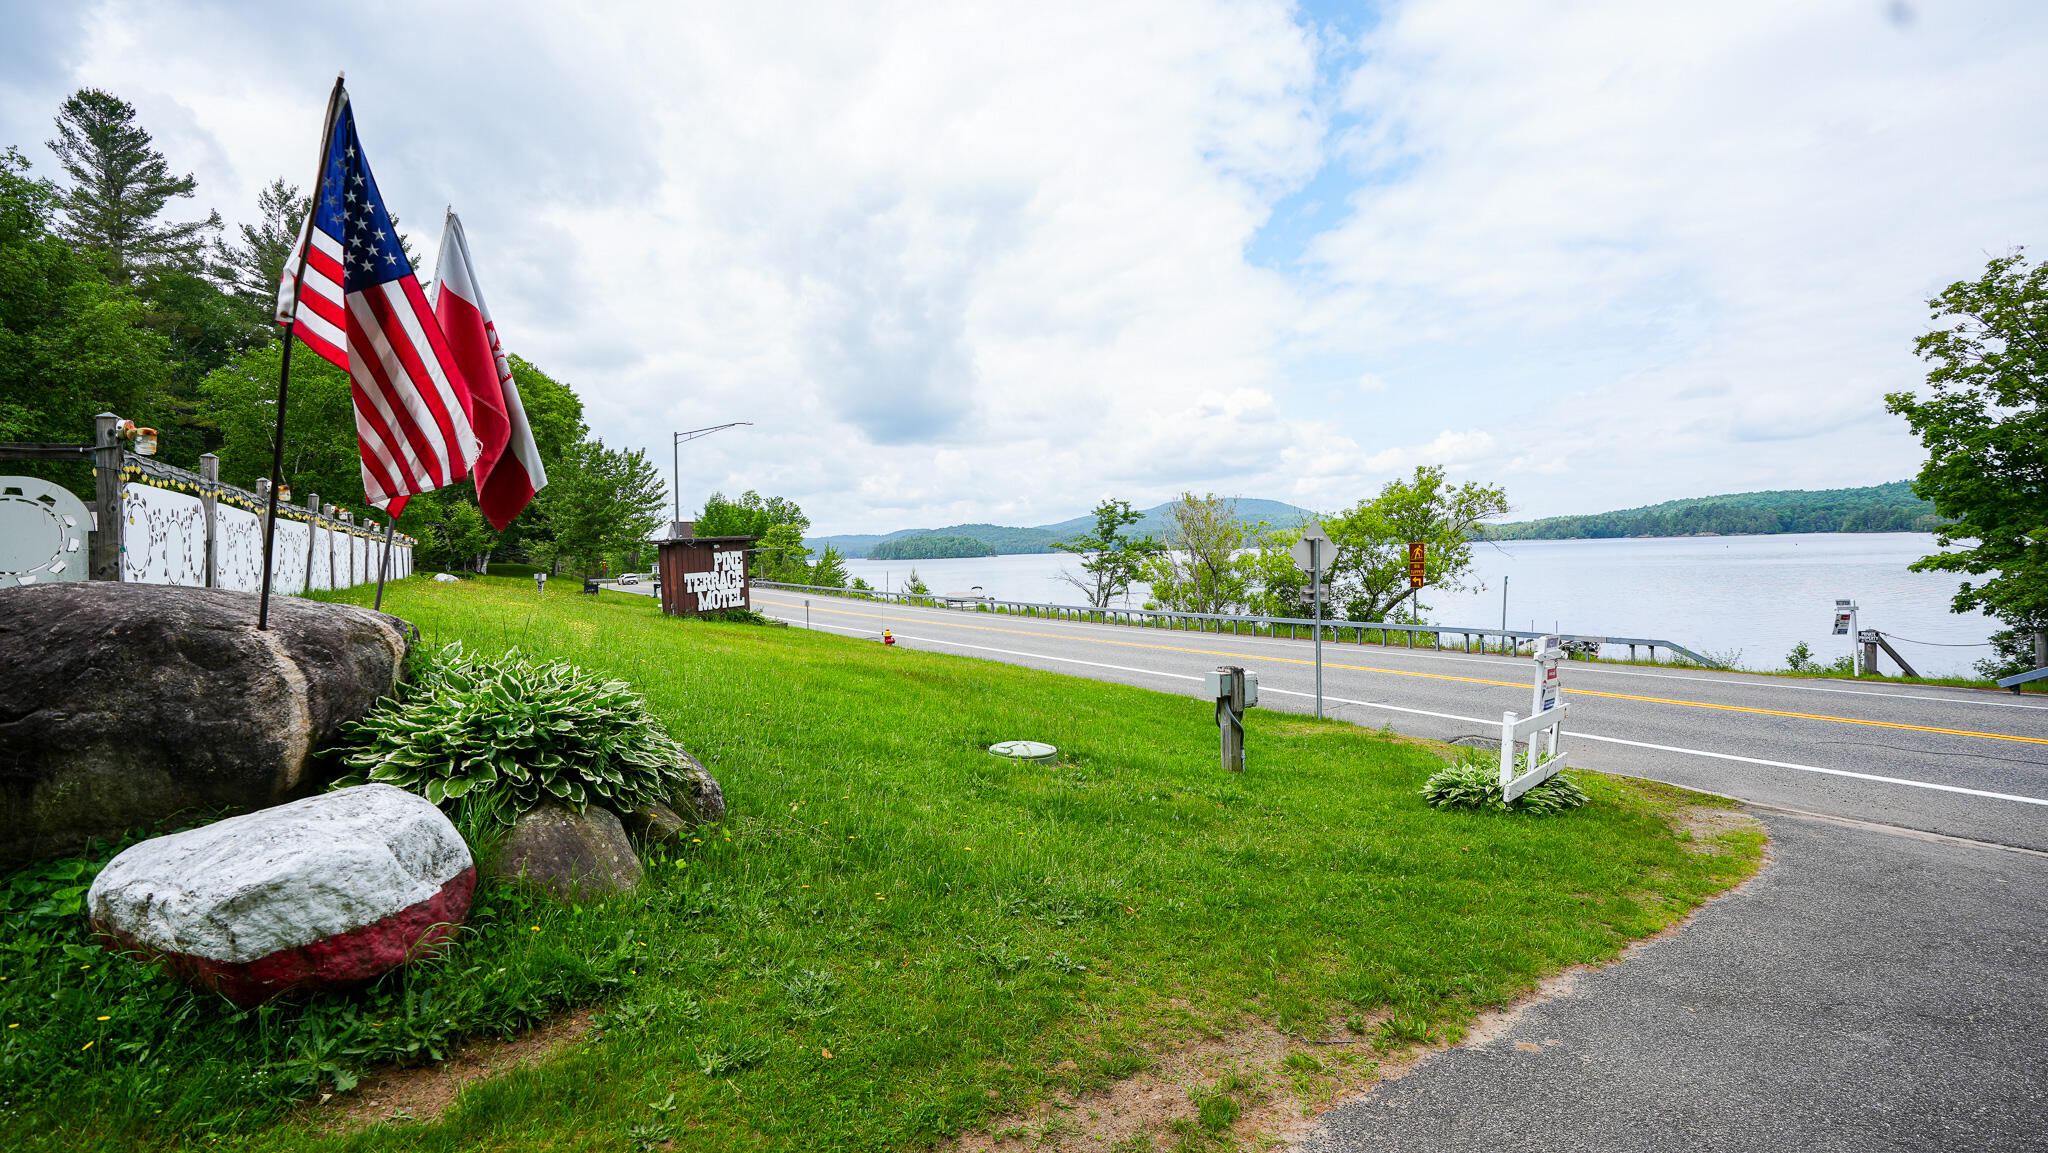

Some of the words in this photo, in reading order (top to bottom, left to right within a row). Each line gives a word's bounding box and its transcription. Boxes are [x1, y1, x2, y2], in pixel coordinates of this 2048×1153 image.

[713, 551, 743, 572] PINE
[684, 570, 744, 593] TERRACE
[697, 588, 745, 611] MOTEL
